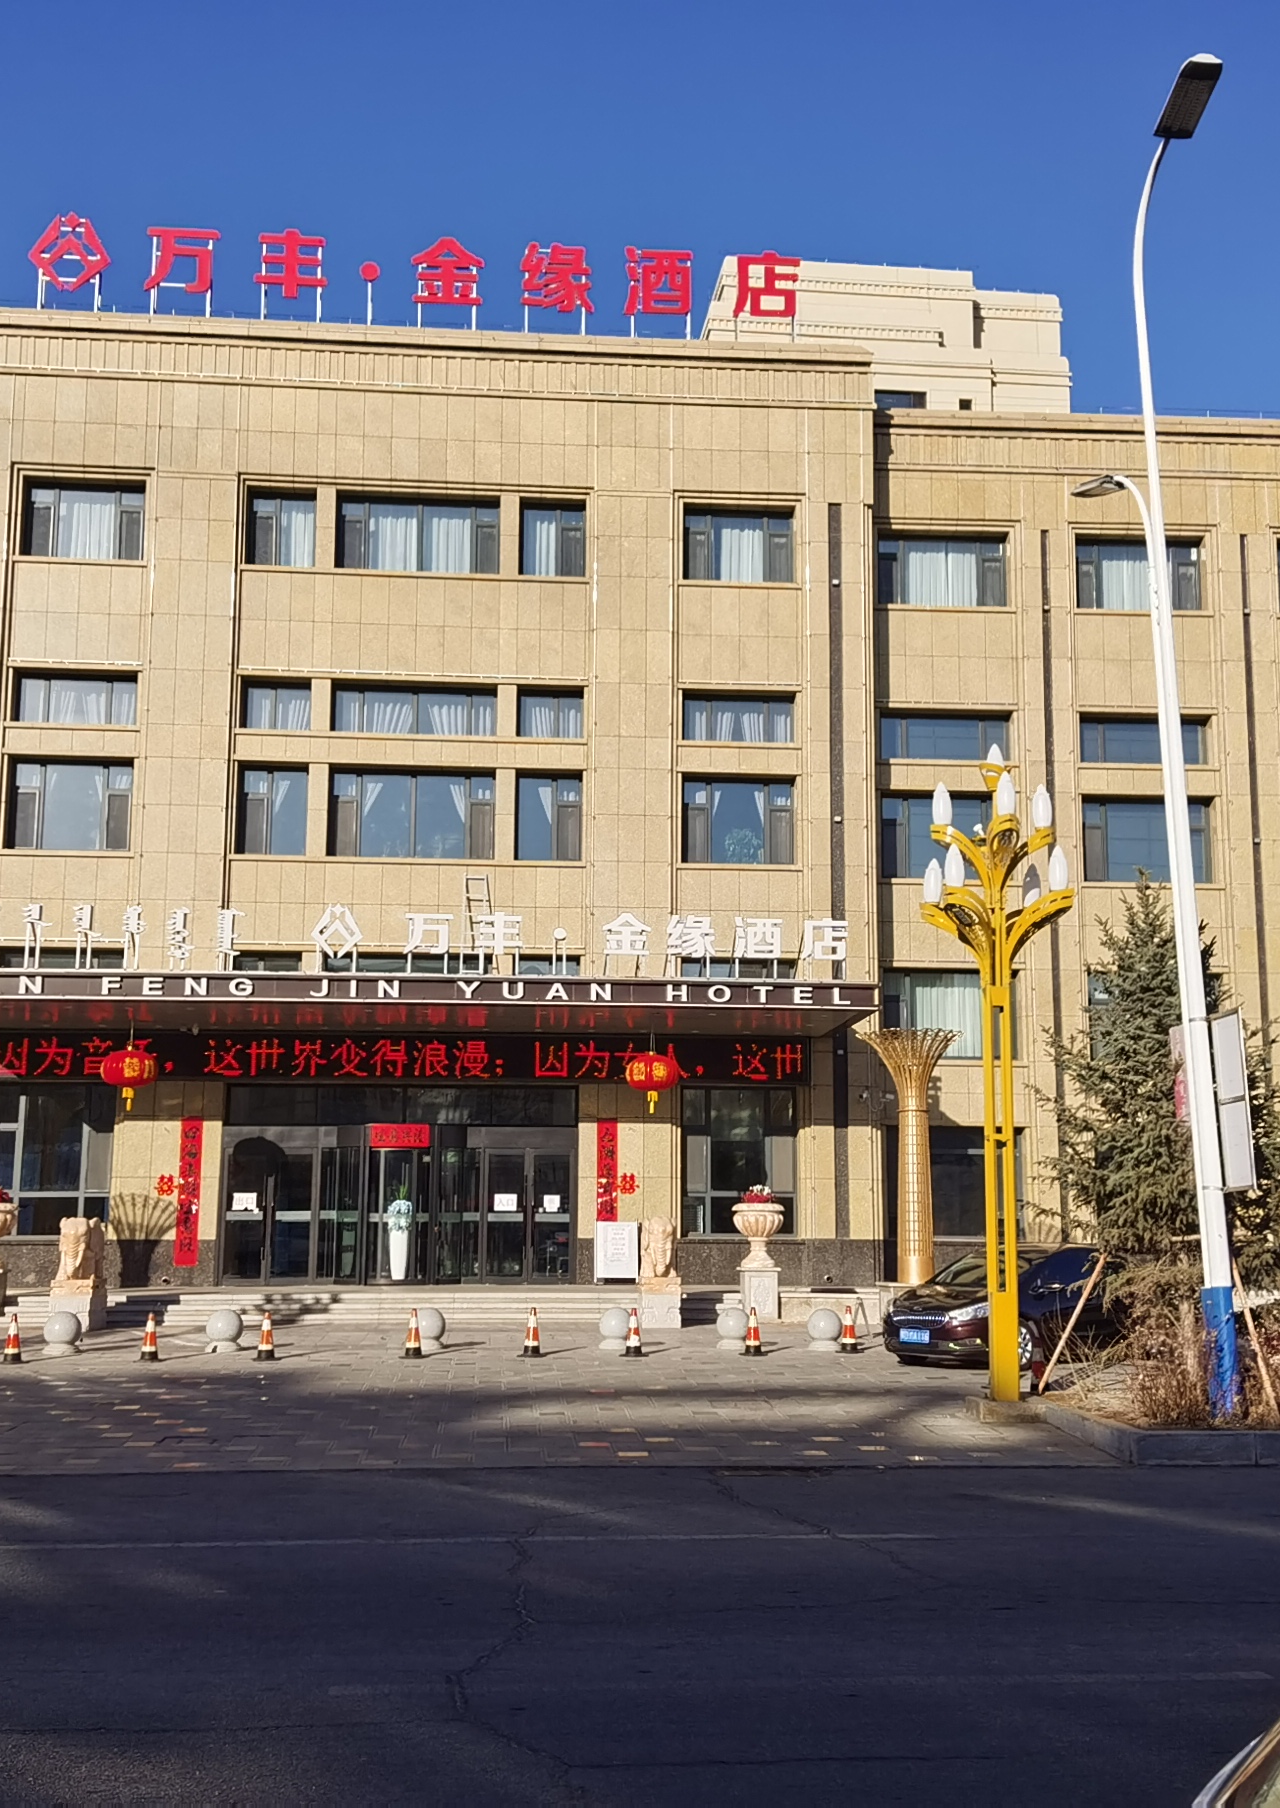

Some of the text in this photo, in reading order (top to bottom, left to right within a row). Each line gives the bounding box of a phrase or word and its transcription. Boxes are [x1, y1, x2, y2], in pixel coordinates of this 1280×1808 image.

[102, 976, 254, 997] FENG
[310, 978, 400, 998] JIN
[457, 980, 612, 1001] YUAN
[666, 984, 852, 1005] HOTEL
